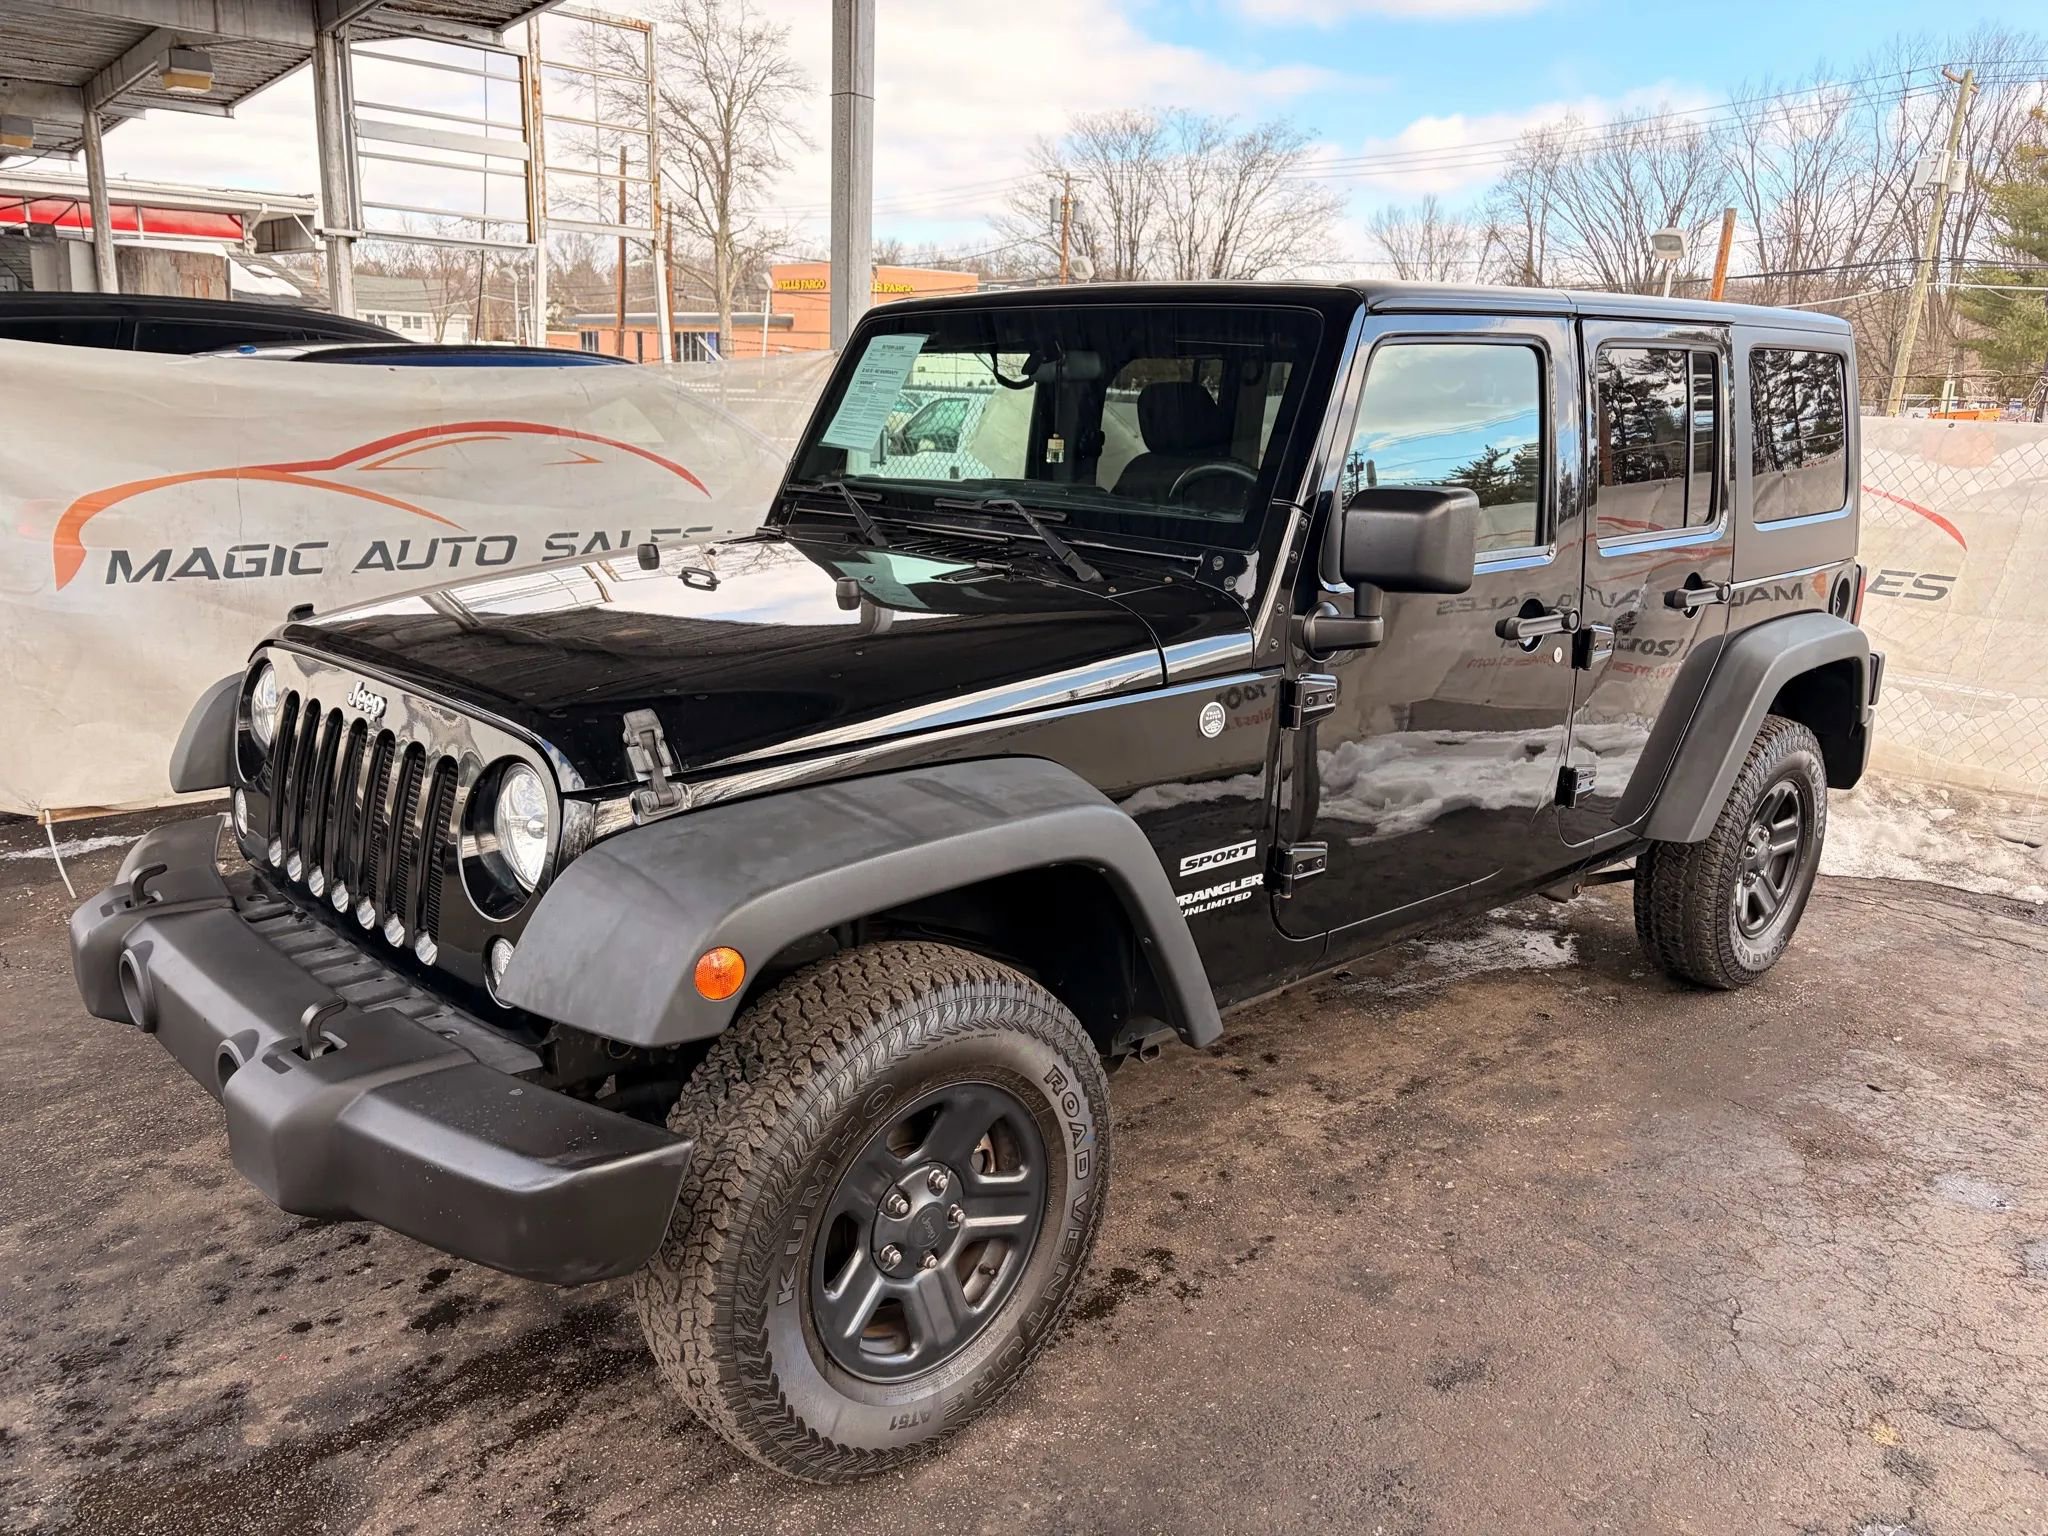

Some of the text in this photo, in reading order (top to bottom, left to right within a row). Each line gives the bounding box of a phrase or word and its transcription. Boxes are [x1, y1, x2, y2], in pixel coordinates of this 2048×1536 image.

[776, 279, 826, 290] WELLS FARGO
[105, 541, 328, 585] MAGIC
[351, 535, 518, 573] AUTO
[347, 681, 387, 721] Jeep
[1185, 846, 1250, 870] SPORT
[1043, 1063, 1092, 1181] ROAD
